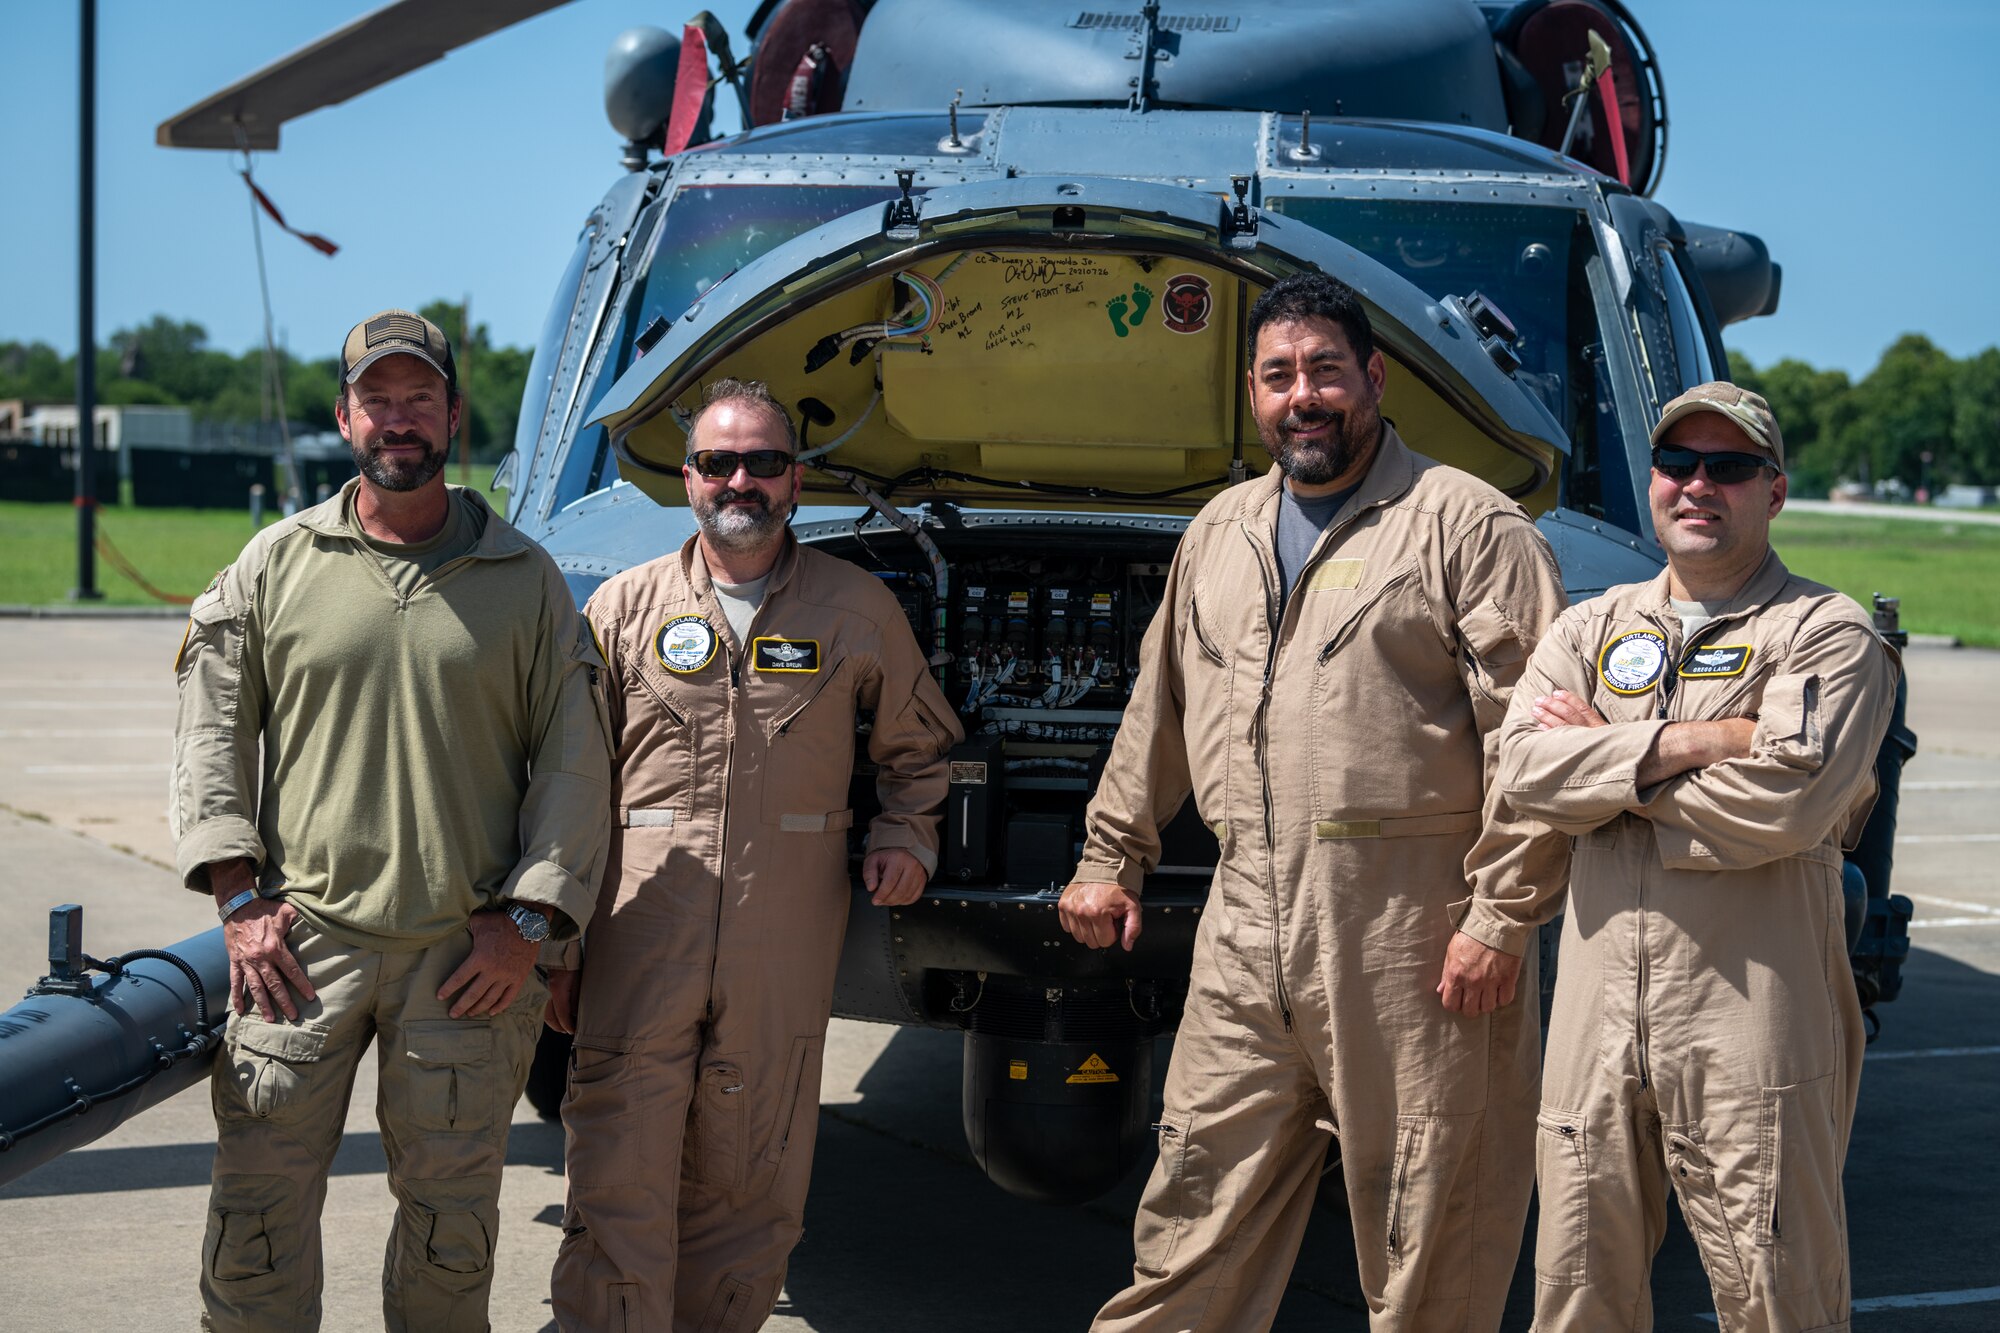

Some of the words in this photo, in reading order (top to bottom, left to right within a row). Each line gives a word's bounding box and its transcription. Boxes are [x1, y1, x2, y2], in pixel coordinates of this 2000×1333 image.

[1068, 267, 1109, 276] 20210726
[665, 616, 698, 629] KIRTLAND
[1621, 632, 1657, 642] KIRTLAND
[1627, 679, 1649, 690] FIRST
